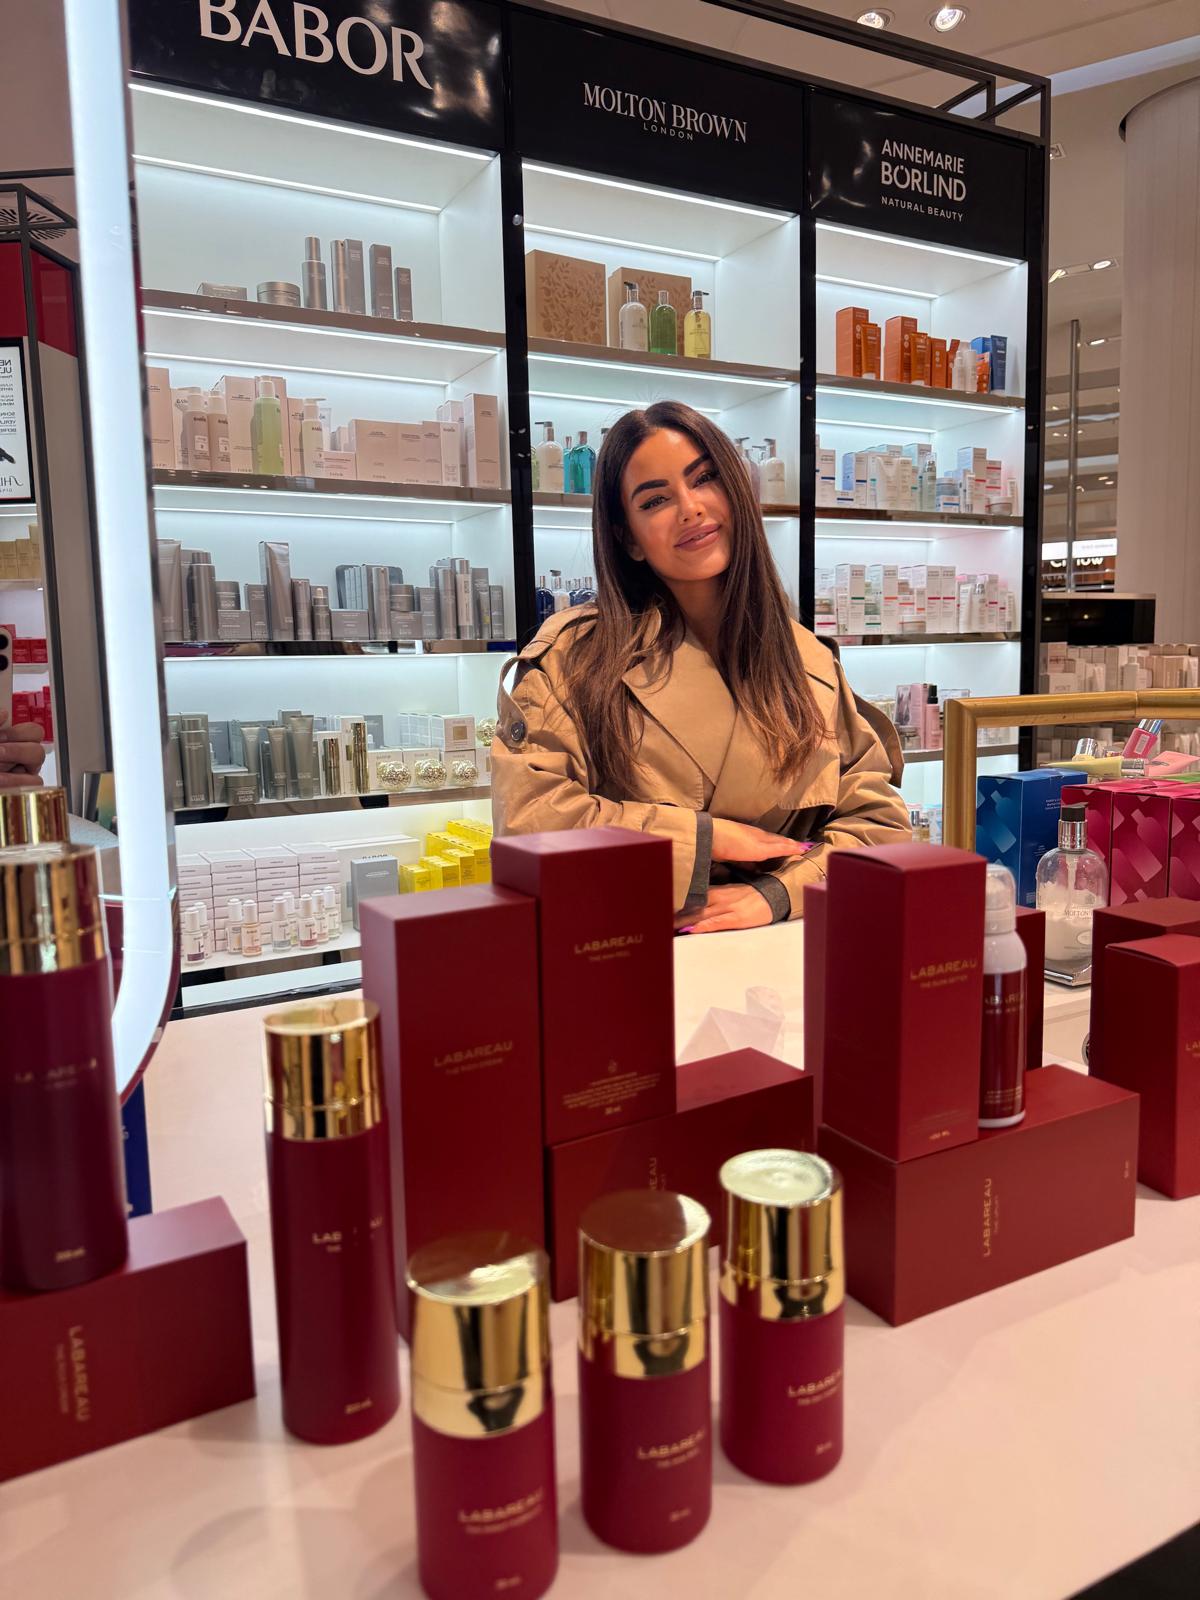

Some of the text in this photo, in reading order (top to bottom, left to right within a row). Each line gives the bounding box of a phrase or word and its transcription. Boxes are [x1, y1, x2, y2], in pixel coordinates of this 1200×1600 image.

[200, 0, 433, 90] BABOR
[583, 82, 748, 144] MOLTON BROWN
[643, 122, 695, 142] LONDON
[881, 138, 965, 174] ANNEMARIE
[881, 196, 964, 223] NATURAL BEAUTY
[574, 933, 643, 955] LABAREAU
[910, 959, 977, 980] LABAREAU
[433, 1040, 514, 1067] LABAREAU
[983, 1178, 992, 1258] LABAREAU
[69, 1325, 91, 1421] LABAREAU
